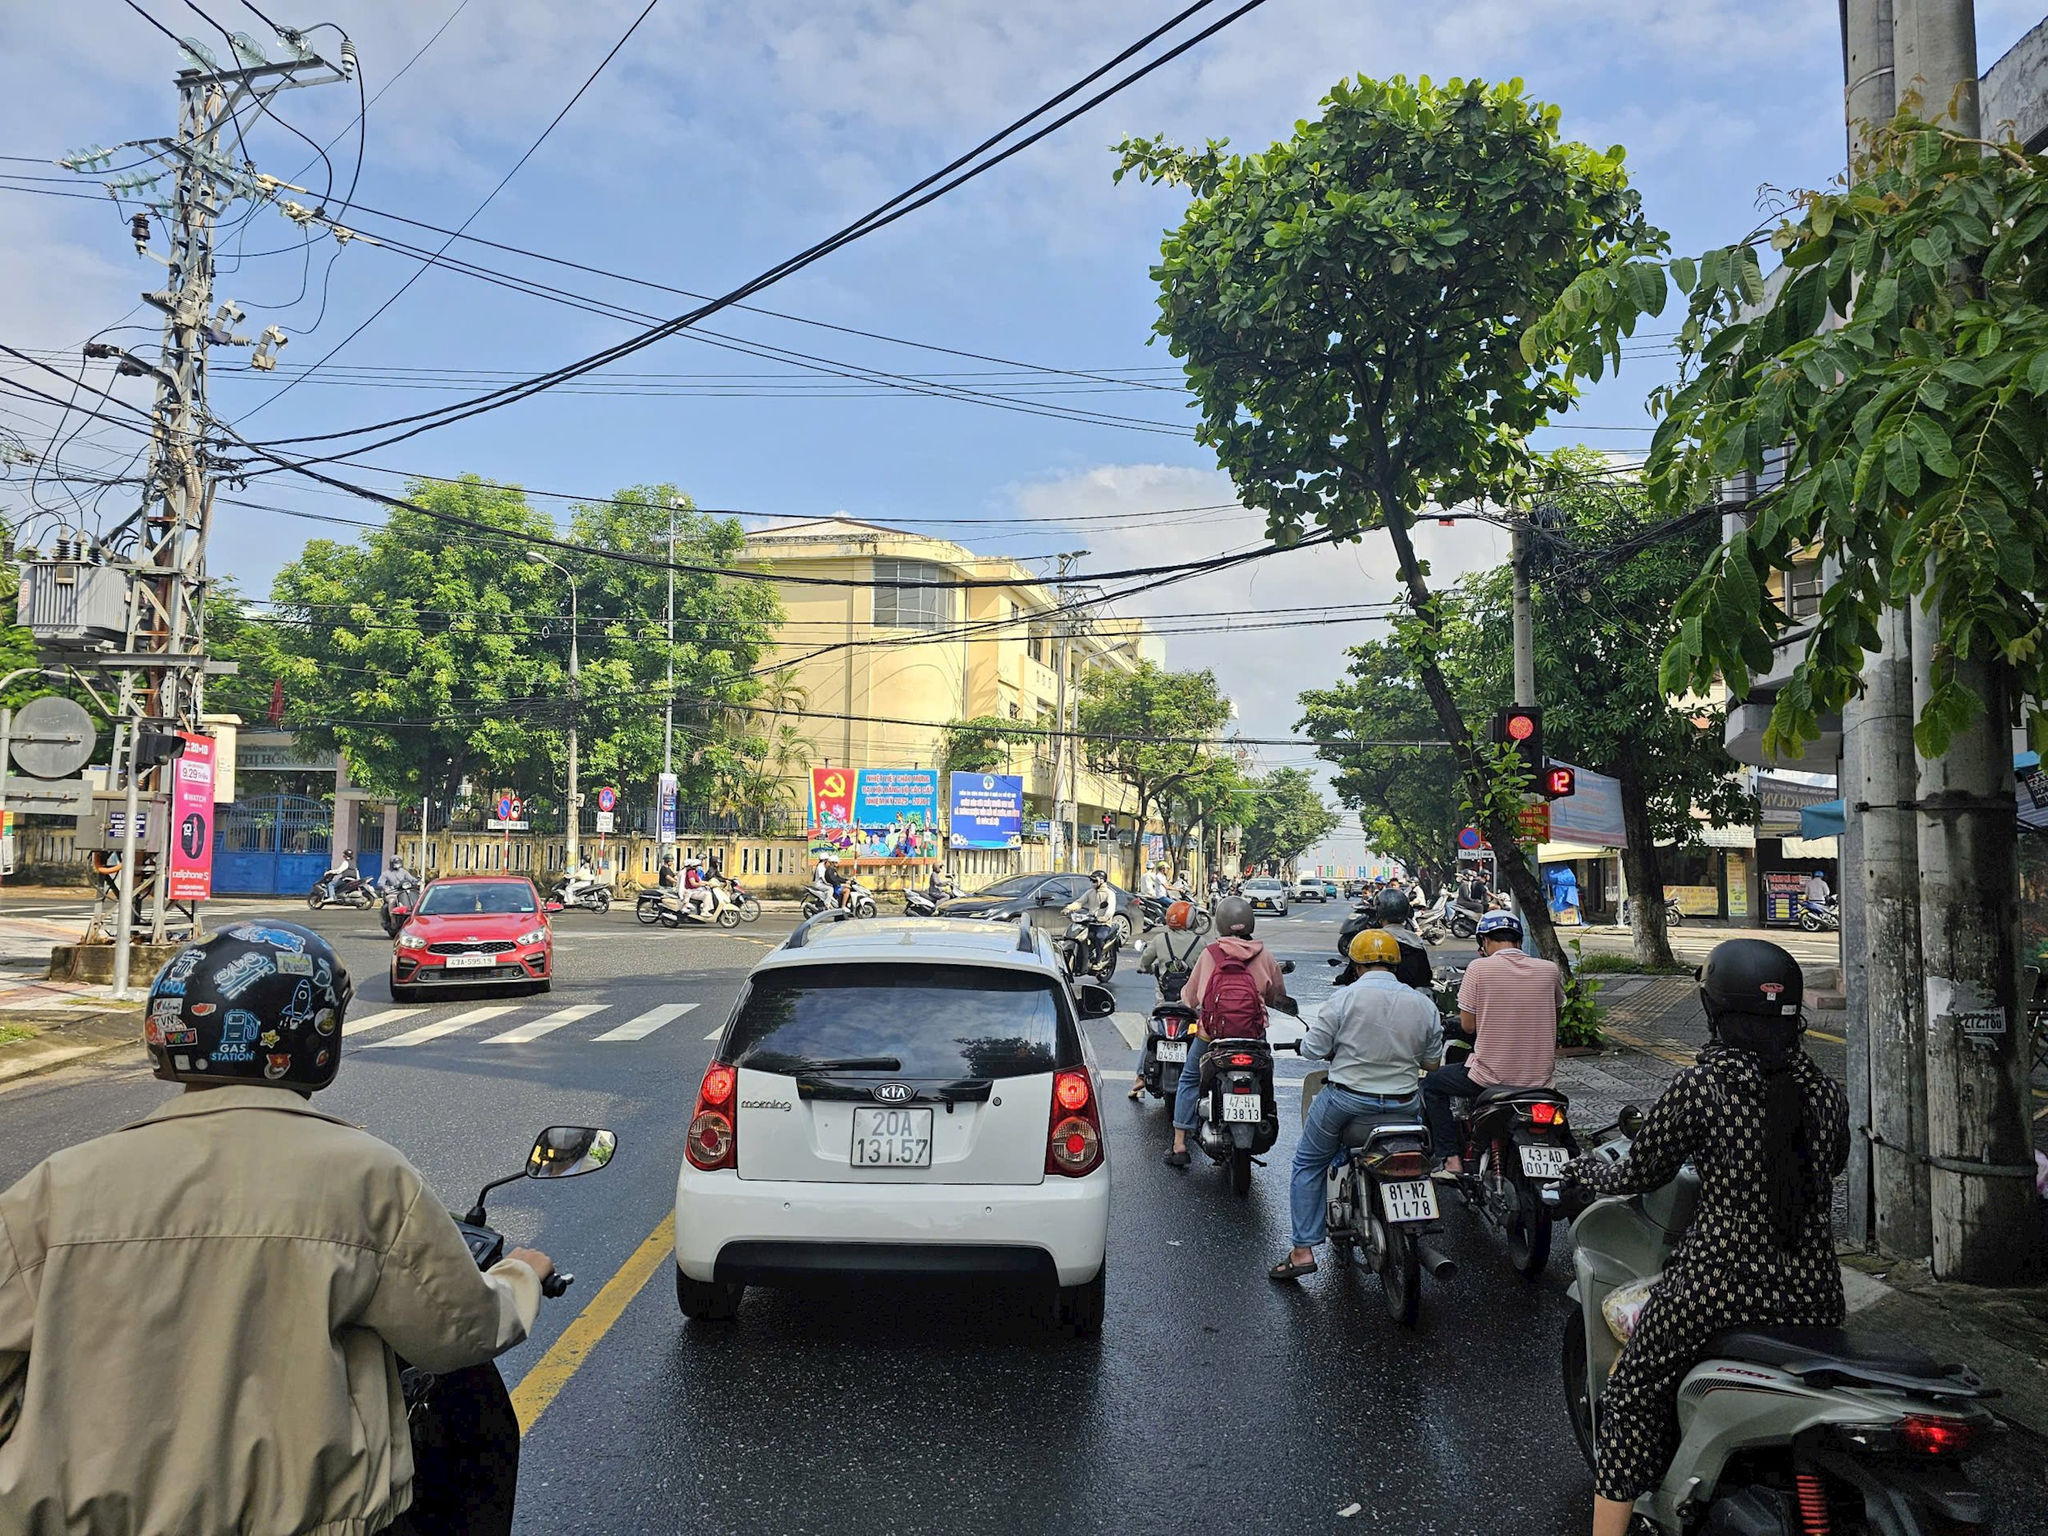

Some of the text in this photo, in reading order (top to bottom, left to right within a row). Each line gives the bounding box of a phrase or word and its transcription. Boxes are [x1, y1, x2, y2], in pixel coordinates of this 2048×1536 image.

[182, 767, 198, 779] 9.29
[1553, 772, 1569, 792] 12
[159, 980, 187, 995] COOL
[219, 1043, 247, 1053] GAS
[210, 1051, 255, 1062] STATION
[881, 1087, 906, 1098] KIA
[741, 1100, 792, 1112] morning
[1229, 1096, 1255, 1108] 47-H1
[1226, 1108, 1259, 1121] 738.13
[872, 1111, 912, 1137] 20A
[857, 1138, 929, 1164] 131.57
[1528, 1149, 1562, 1163] 43-AD
[1389, 1182, 1426, 1201] 81-N2
[1393, 1200, 1431, 1219] 1478
